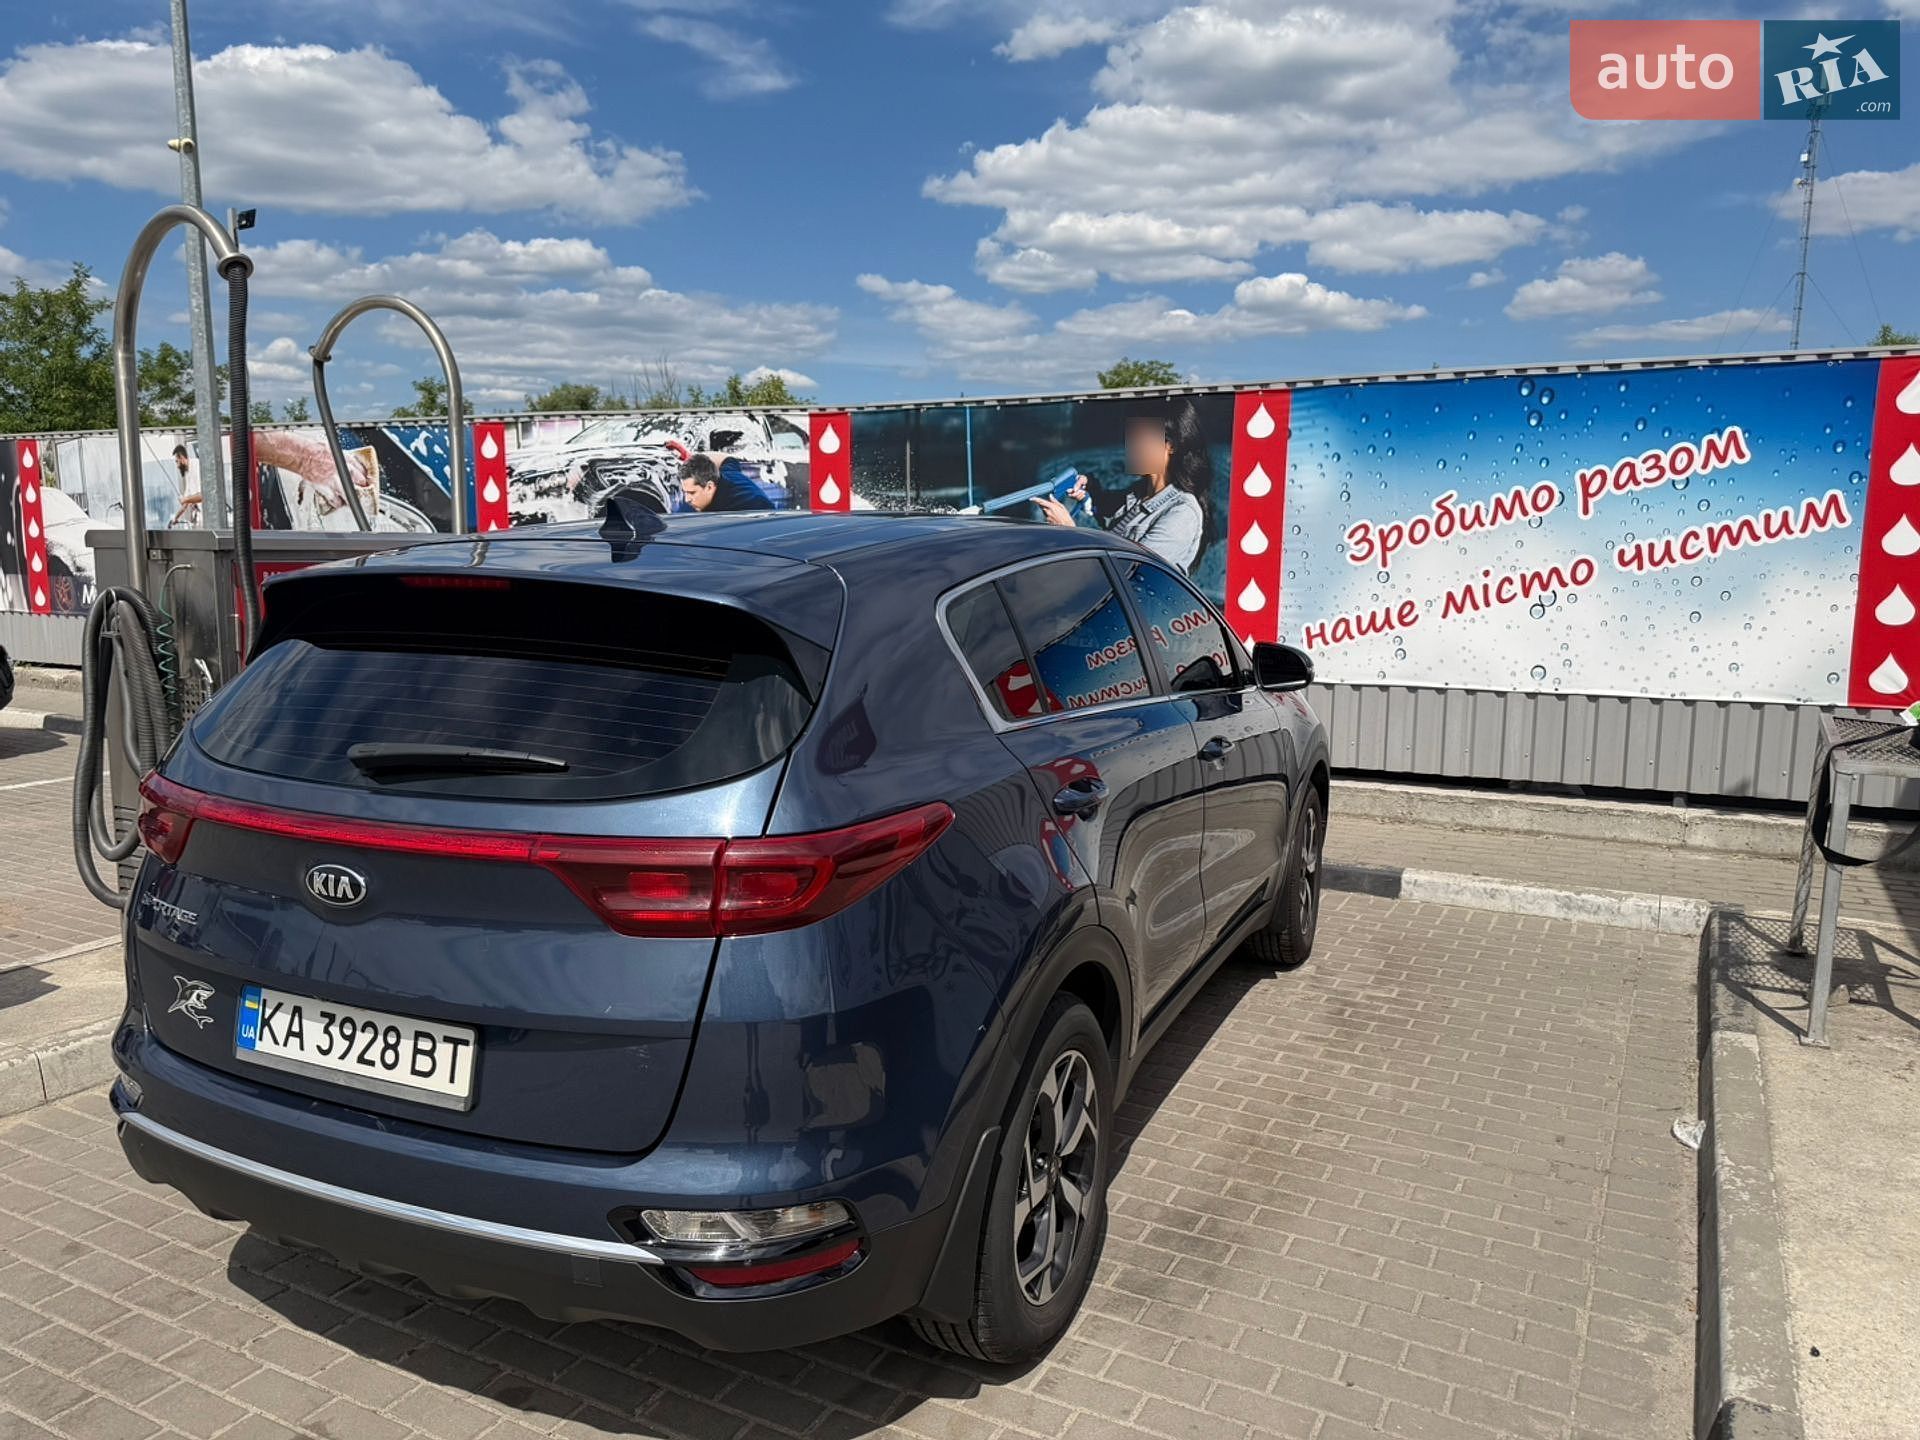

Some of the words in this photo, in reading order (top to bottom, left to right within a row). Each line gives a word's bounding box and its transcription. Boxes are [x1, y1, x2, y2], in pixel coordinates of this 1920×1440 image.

[1347, 485, 1556, 568] Зробимо
[1579, 431, 1747, 516] разом
[1304, 600, 1419, 649] наше
[1441, 559, 1596, 620] місто
[1616, 494, 1848, 573] чистим
[312, 872, 356, 899] KIA
[241, 1022, 257, 1040] UA
[258, 998, 305, 1051] KA
[316, 1010, 402, 1071] 3928
[410, 1029, 471, 1084] BT
